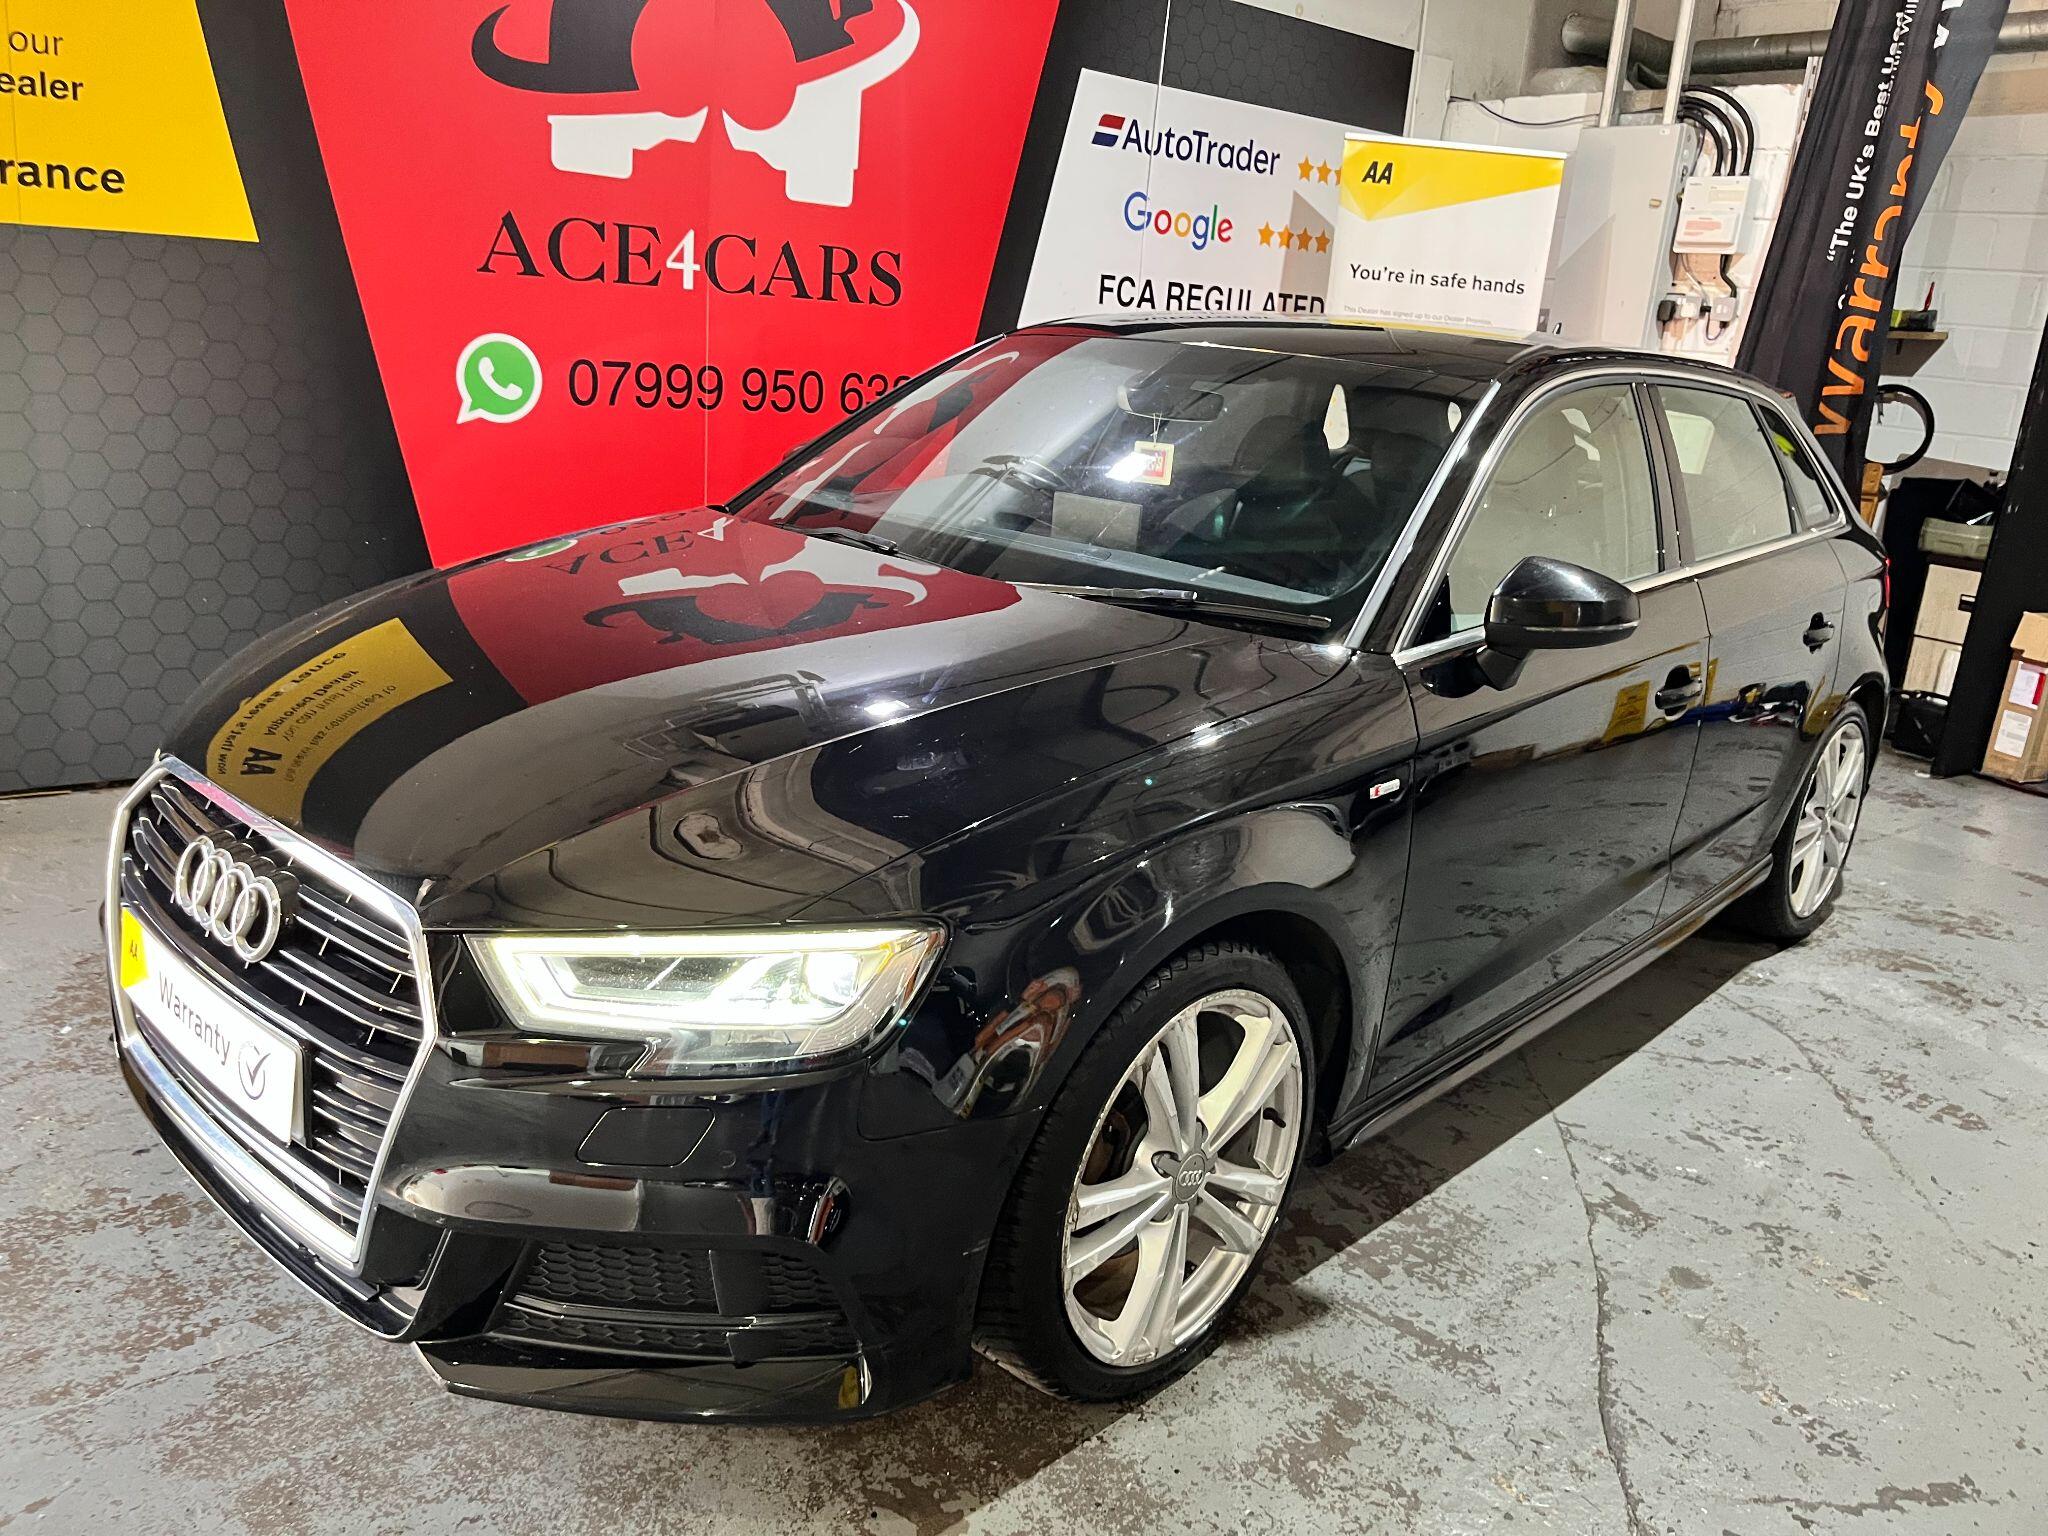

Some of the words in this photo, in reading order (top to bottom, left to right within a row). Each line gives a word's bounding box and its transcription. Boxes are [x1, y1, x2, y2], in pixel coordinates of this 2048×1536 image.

[8, 31, 63, 56] our
[0, 71, 84, 101] ealer
[1122, 119, 1281, 175] AutoTrader
[0, 159, 125, 193] rance
[1362, 161, 1394, 185] AA
[1124, 191, 1234, 251] Google
[477, 210, 902, 306] ACE4CARS
[1099, 274, 1156, 309] FCA
[1350, 263, 1405, 283] You're
[1410, 269, 1425, 285] in
[1430, 273, 1467, 288] safe
[1472, 276, 1525, 295] hands
[569, 359, 724, 411] 07999
[741, 367, 825, 414] 950
[159, 971, 231, 1066] Warranty
